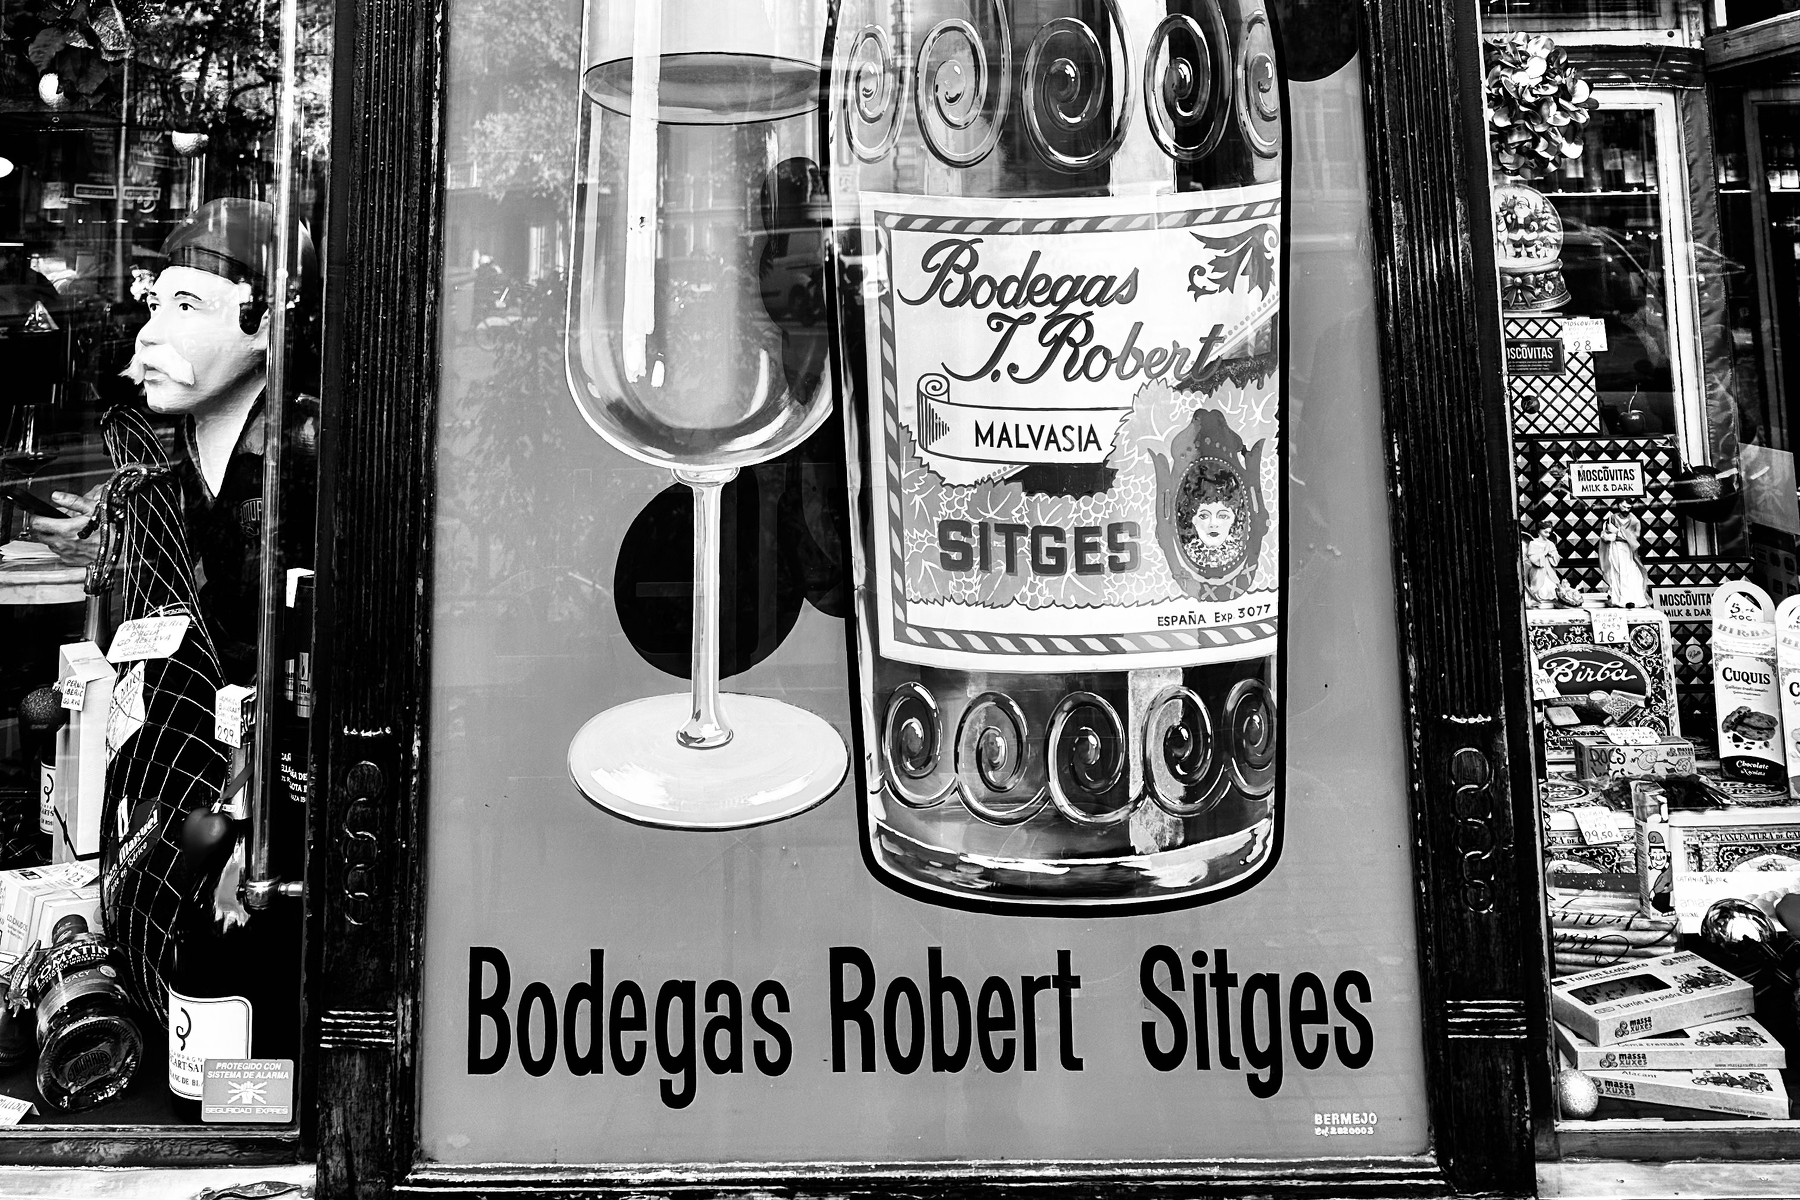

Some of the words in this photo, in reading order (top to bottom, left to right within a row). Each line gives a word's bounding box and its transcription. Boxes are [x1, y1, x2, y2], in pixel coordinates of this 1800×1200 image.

[896, 237, 1139, 321] Bodegas
[1007, 310, 1226, 385] Robert
[1573, 340, 1592, 351] 28
[974, 419, 1103, 452] MALVASIA
[1581, 484, 1601, 492] MILK
[1603, 484, 1609, 492] &
[1611, 484, 1634, 492] DARK
[937, 518, 1141, 577] SITGES
[1157, 610, 1207, 627] ESPAÑA
[1237, 604, 1272, 619] 3077
[1664, 609, 1683, 617] MILK
[1685, 608, 1692, 617] &
[1598, 631, 1615, 642] 16
[1543, 656, 1638, 683] Birba
[1722, 666, 1771, 685] CUQUIS
[217, 724, 235, 743] 229
[1735, 759, 1770, 770] Chocolate
[33, 944, 110, 990] TOMATIN
[465, 945, 794, 1109] Bodegas
[827, 946, 1085, 1074] Robert
[1139, 944, 1376, 1099] Sitges
[1629, 1016, 1652, 1026] massa
[215, 1062, 263, 1071] PROTEGIDO
[264, 1062, 282, 1071] CON
[206, 1070, 241, 1079] SISTEMA
[242, 1070, 255, 1079] DE
[255, 1070, 290, 1079] ALARMA
[1604, 1079, 1635, 1090] massa
[1605, 1086, 1636, 1096] xuxes
[204, 1107, 253, 1115] SEGURIDAD
[255, 1107, 289, 1115] EXPRES
[1314, 1111, 1378, 1125] BERMEJO
